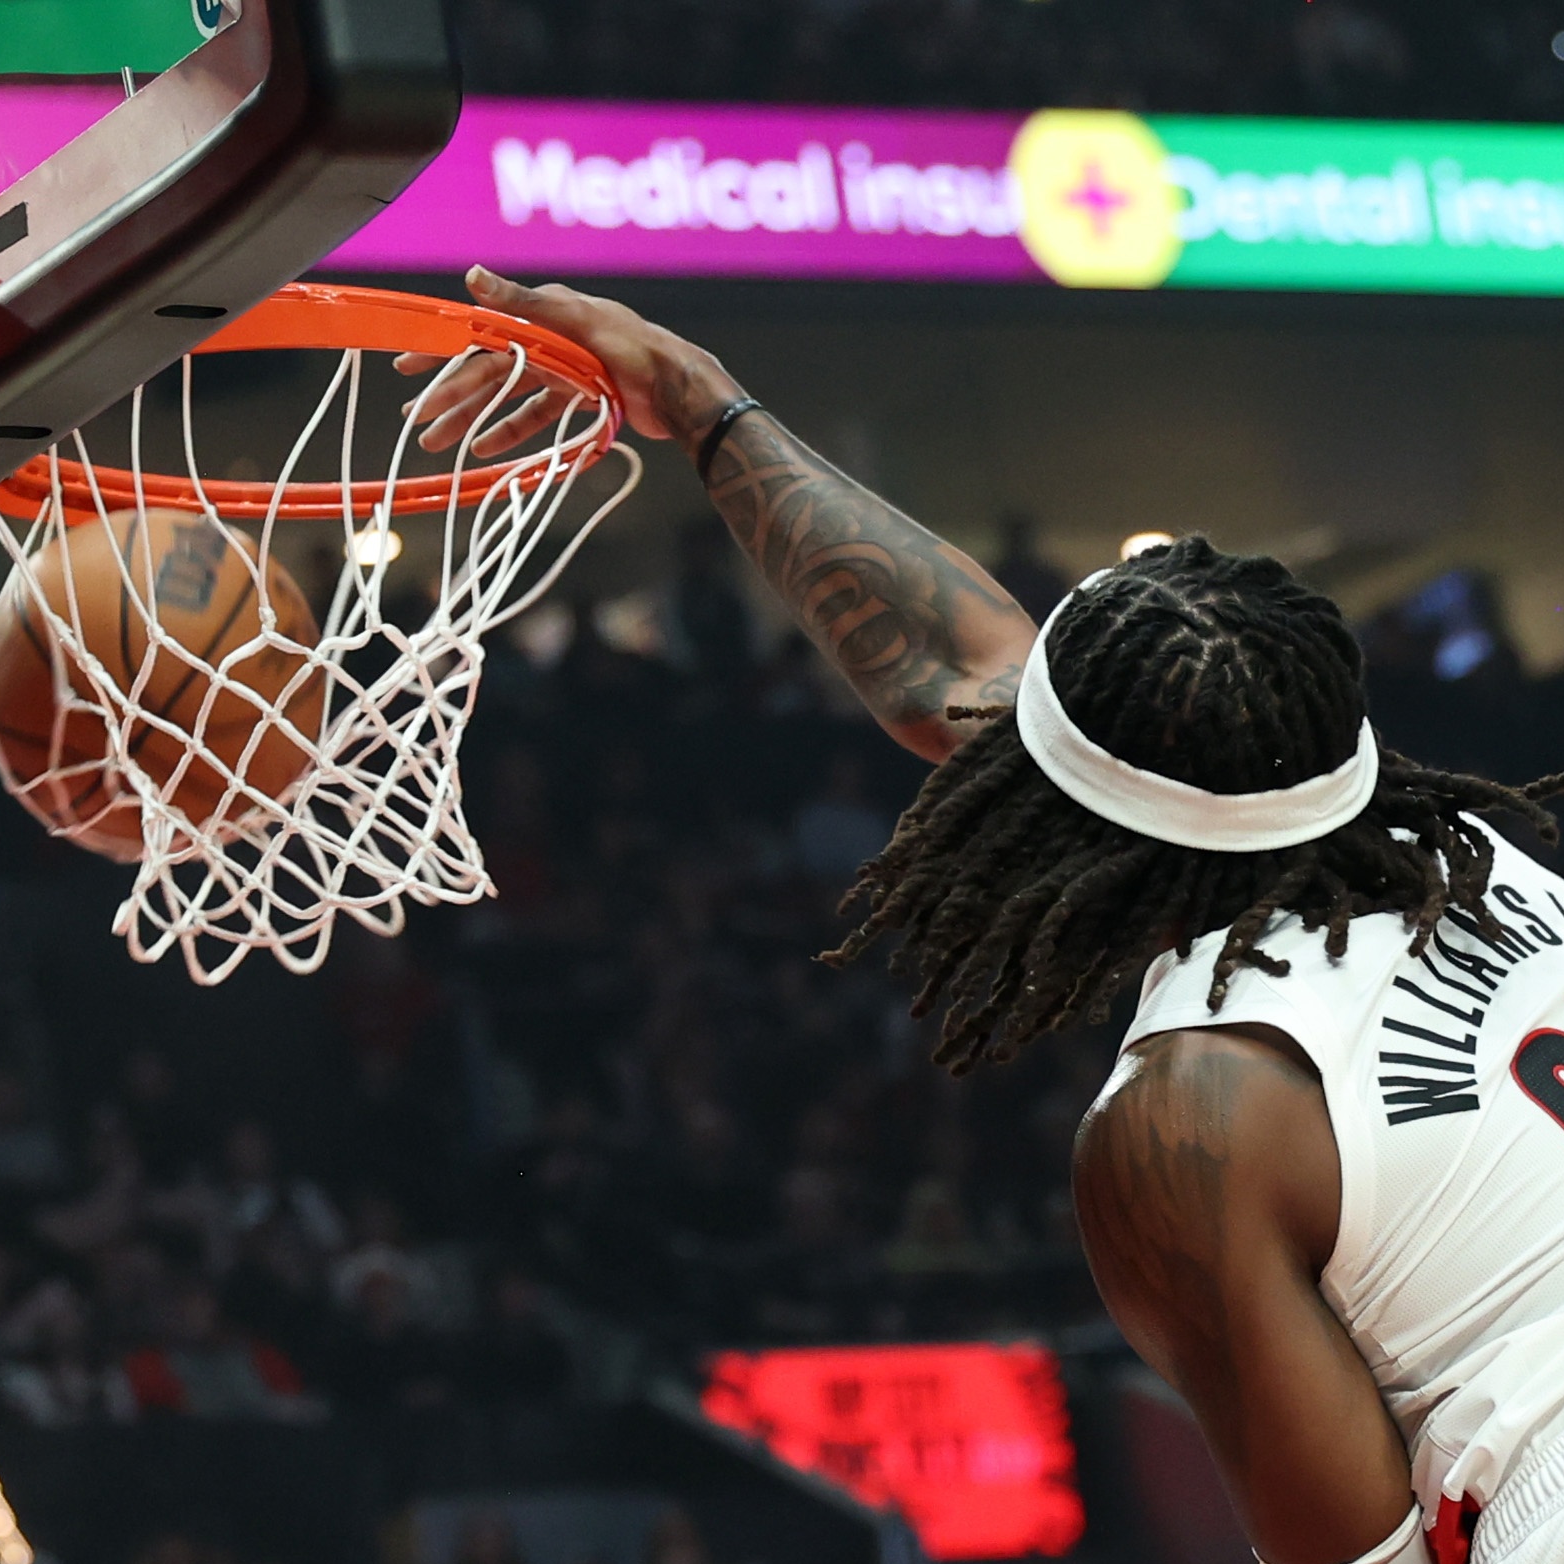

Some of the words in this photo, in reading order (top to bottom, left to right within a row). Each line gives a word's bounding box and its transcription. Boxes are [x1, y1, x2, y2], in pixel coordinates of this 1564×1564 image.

[492, 137, 834, 234] Medical
[1163, 152, 1421, 246] Dental
[1377, 884, 1563, 1126] WILLIAMS
